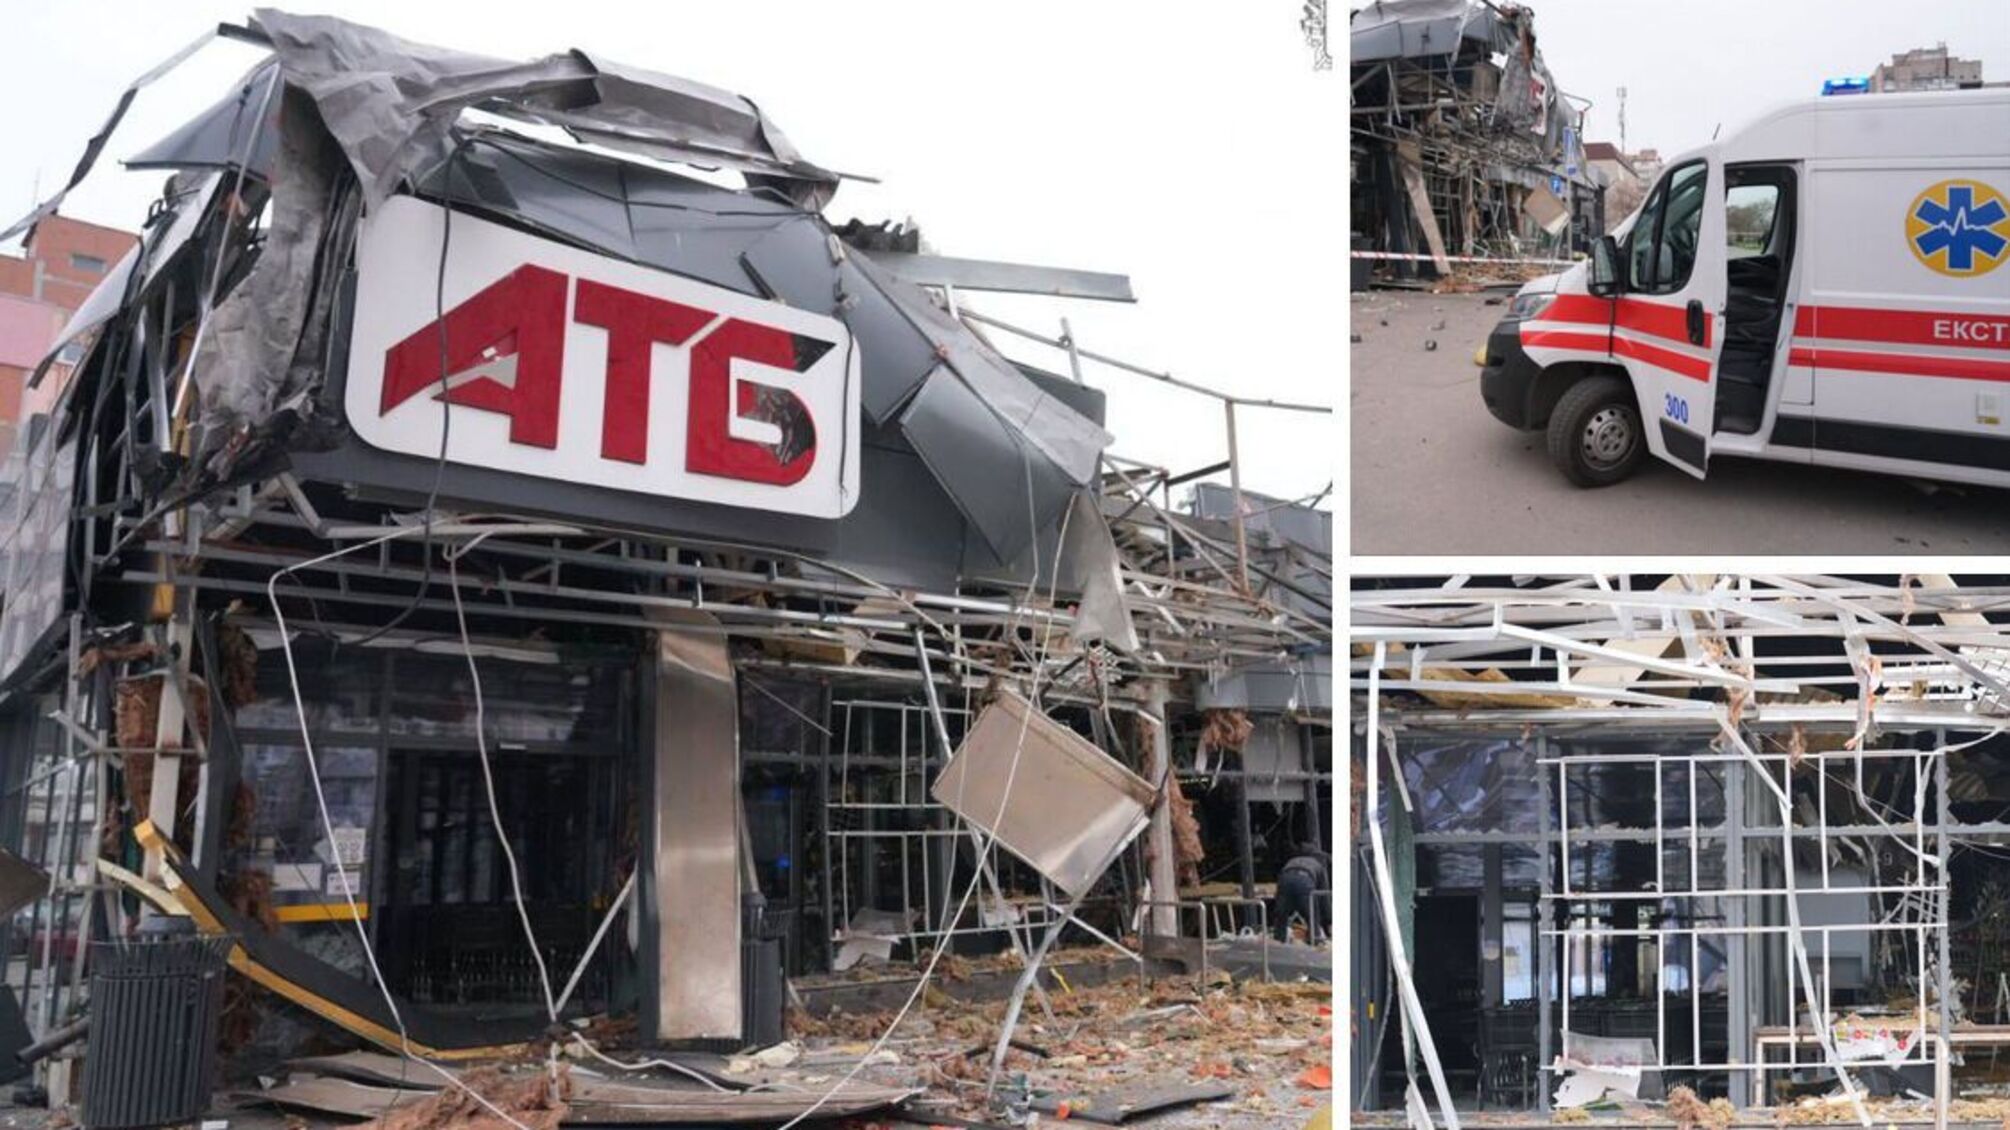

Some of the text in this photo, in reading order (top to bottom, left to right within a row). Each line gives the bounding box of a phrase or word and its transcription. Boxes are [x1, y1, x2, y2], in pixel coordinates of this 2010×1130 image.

[1934, 319, 2009, 342] ЕКСТ
[379, 263, 836, 487] АТБ
[1665, 393, 1689, 424] 300
